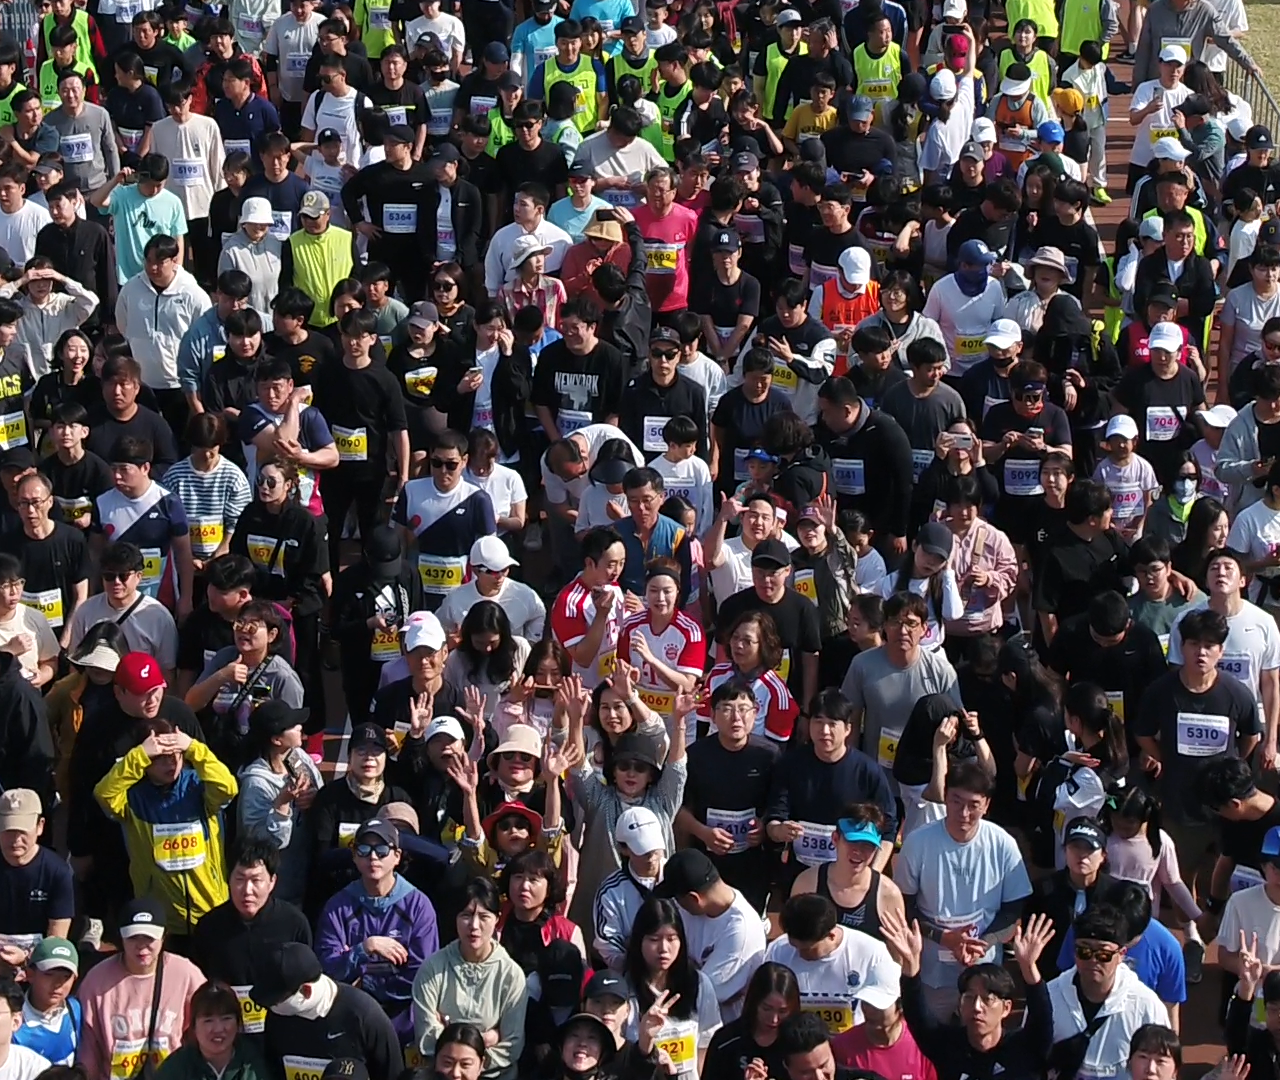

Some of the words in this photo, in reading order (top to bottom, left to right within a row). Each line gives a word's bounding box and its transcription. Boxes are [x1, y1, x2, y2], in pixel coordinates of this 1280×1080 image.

[389, 213, 411, 221] 5364
[0, 424, 20, 435] 4774
[1012, 471, 1037, 480] 5092
[425, 569, 453, 580] 4370
[641, 695, 669, 706] 6067
[1187, 728, 1219, 740] 5310
[163, 837, 197, 850] 6608
